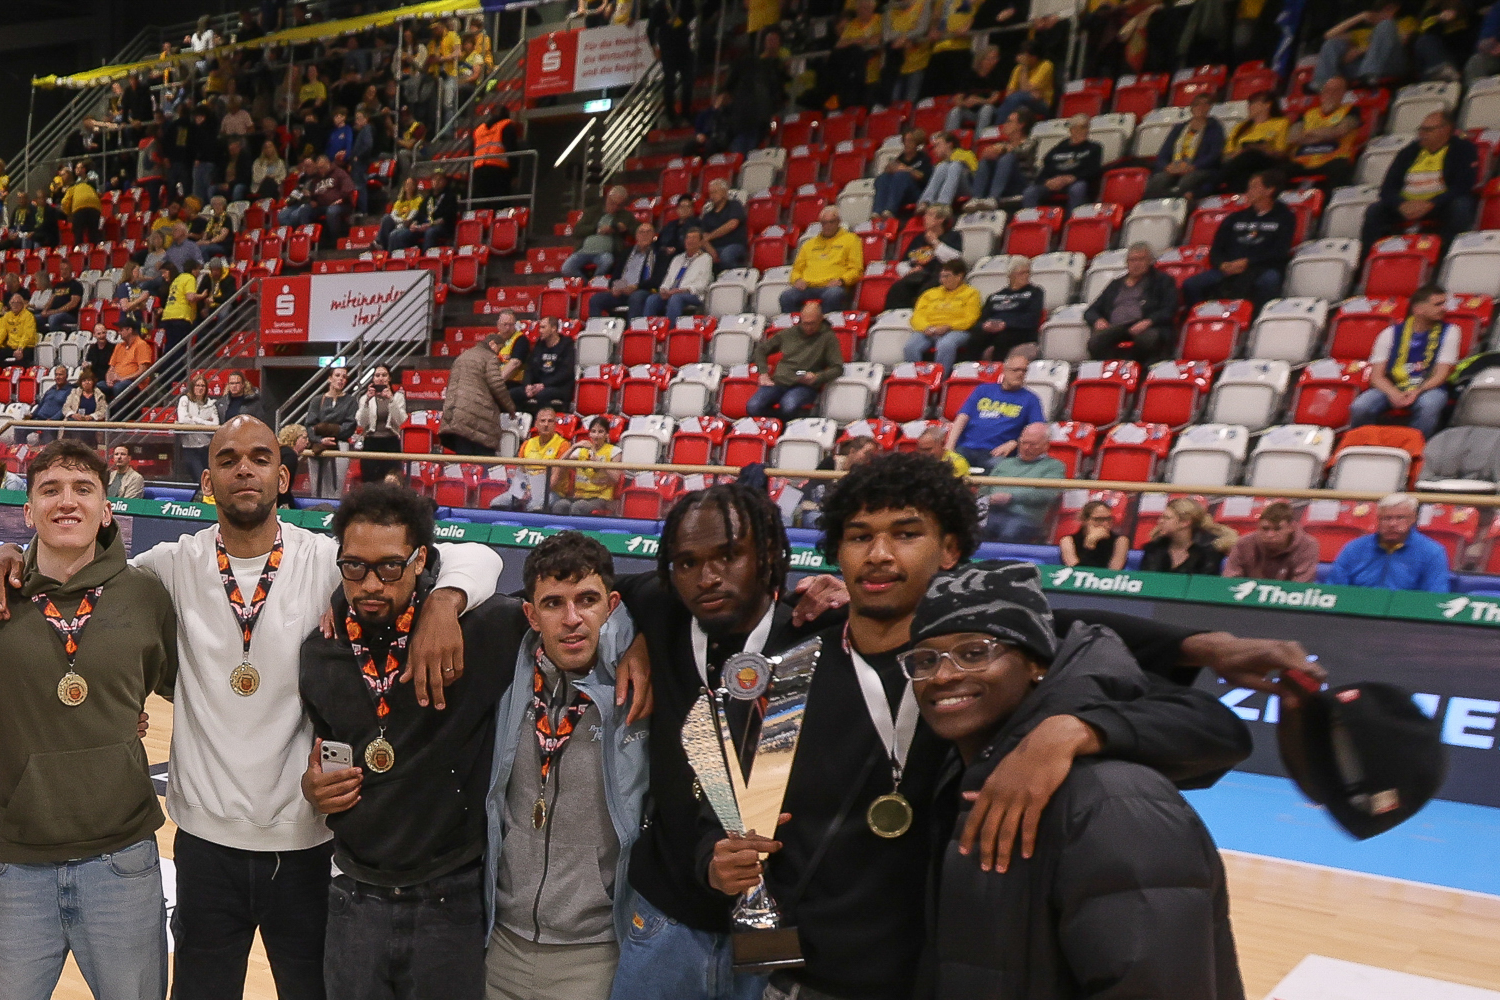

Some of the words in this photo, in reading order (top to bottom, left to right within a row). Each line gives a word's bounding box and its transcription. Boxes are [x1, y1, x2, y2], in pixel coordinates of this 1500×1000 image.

[110, 502, 128, 512] alia
[171, 504, 202, 518] Thalia
[433, 524, 466, 539] halia
[1072, 571, 1143, 593] Thalia
[1256, 583, 1338, 609] Thalia
